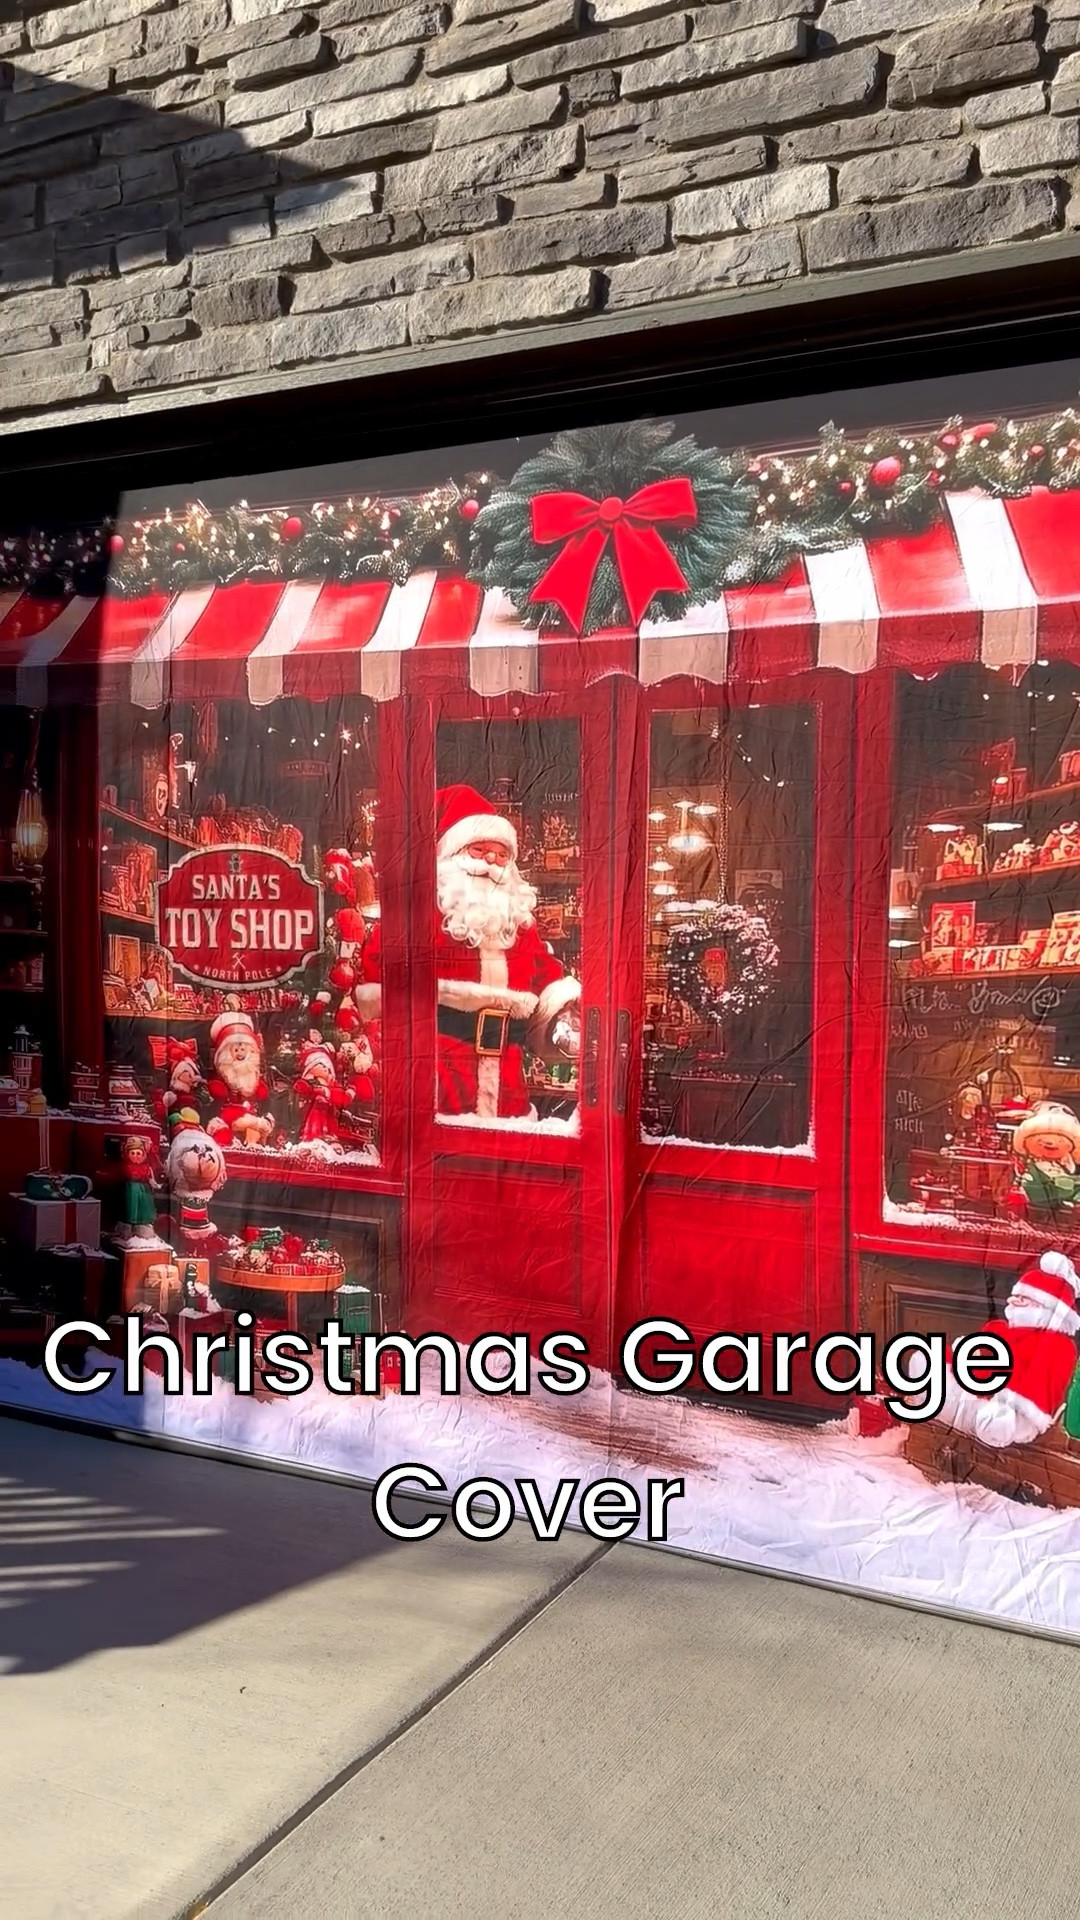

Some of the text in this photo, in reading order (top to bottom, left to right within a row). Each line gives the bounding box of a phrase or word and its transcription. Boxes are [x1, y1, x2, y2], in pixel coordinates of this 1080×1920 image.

[191, 874, 281, 901] SANTA'S
[164, 907, 314, 951] TOY SHOP
[202, 966, 273, 980] NORTH POLE
